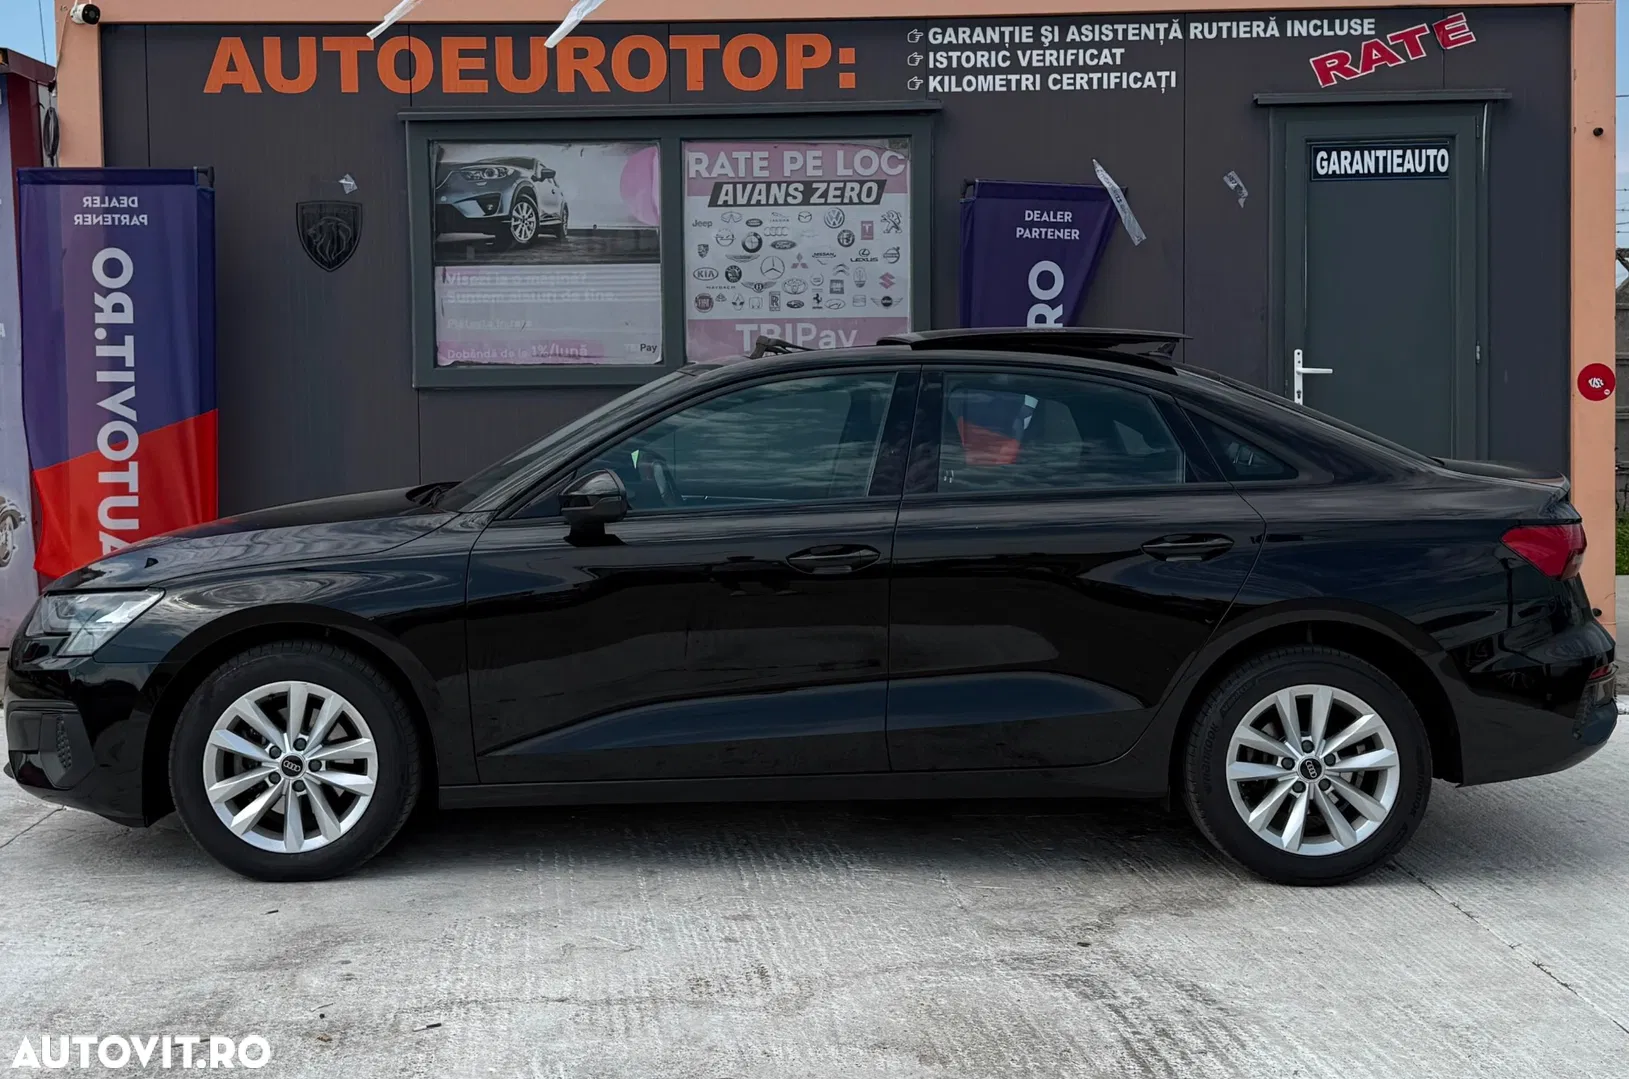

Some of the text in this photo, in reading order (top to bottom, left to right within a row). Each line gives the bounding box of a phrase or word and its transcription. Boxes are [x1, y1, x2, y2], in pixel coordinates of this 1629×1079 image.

[1190, 17, 1280, 39] RUTIERĂ
[1287, 18, 1376, 37] INCLUSE
[928, 48, 1125, 68] ISTORIC VERIFICAT
[1309, 12, 1476, 88] RATE
[203, 33, 855, 94] AUTOEUROTOP:
[928, 73, 1041, 92] KILOMETRI
[688, 149, 907, 178] RATE PE LOC
[1316, 149, 1449, 175] GARANTIEAUTO
[717, 181, 879, 205] AVANS ZERO
[692, 220, 713, 228] Jeep
[1024, 210, 1073, 223] DEALER
[1016, 227, 1080, 240] PARTENER
